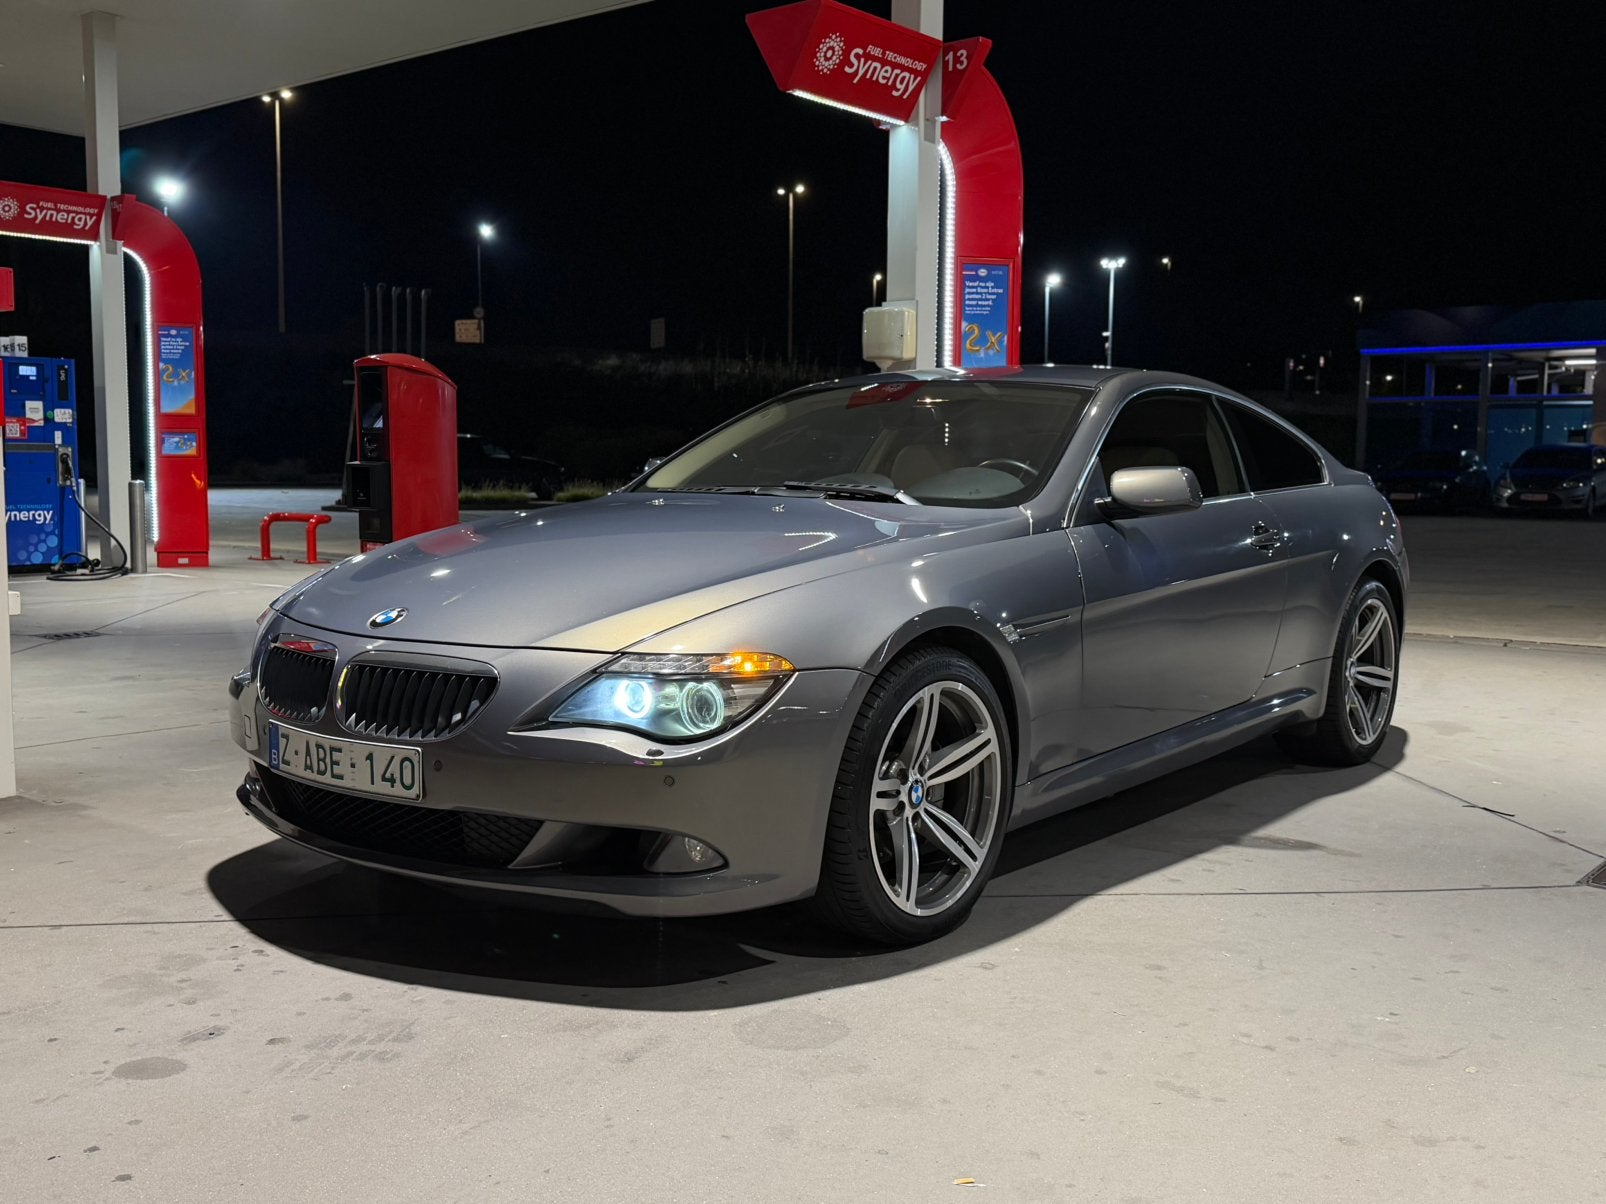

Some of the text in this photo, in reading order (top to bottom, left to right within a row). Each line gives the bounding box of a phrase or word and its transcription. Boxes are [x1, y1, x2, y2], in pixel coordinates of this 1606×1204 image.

[866, 45, 927, 71] FUEL TECHNOLOGY
[944, 49, 968, 71] 13
[844, 47, 922, 99] Synergy
[24, 203, 97, 230] Synergy
[39, 201, 98, 214] FUEL TECHNOLOGY
[16, 342, 27, 352] 15
[5, 510, 53, 524] ynergy
